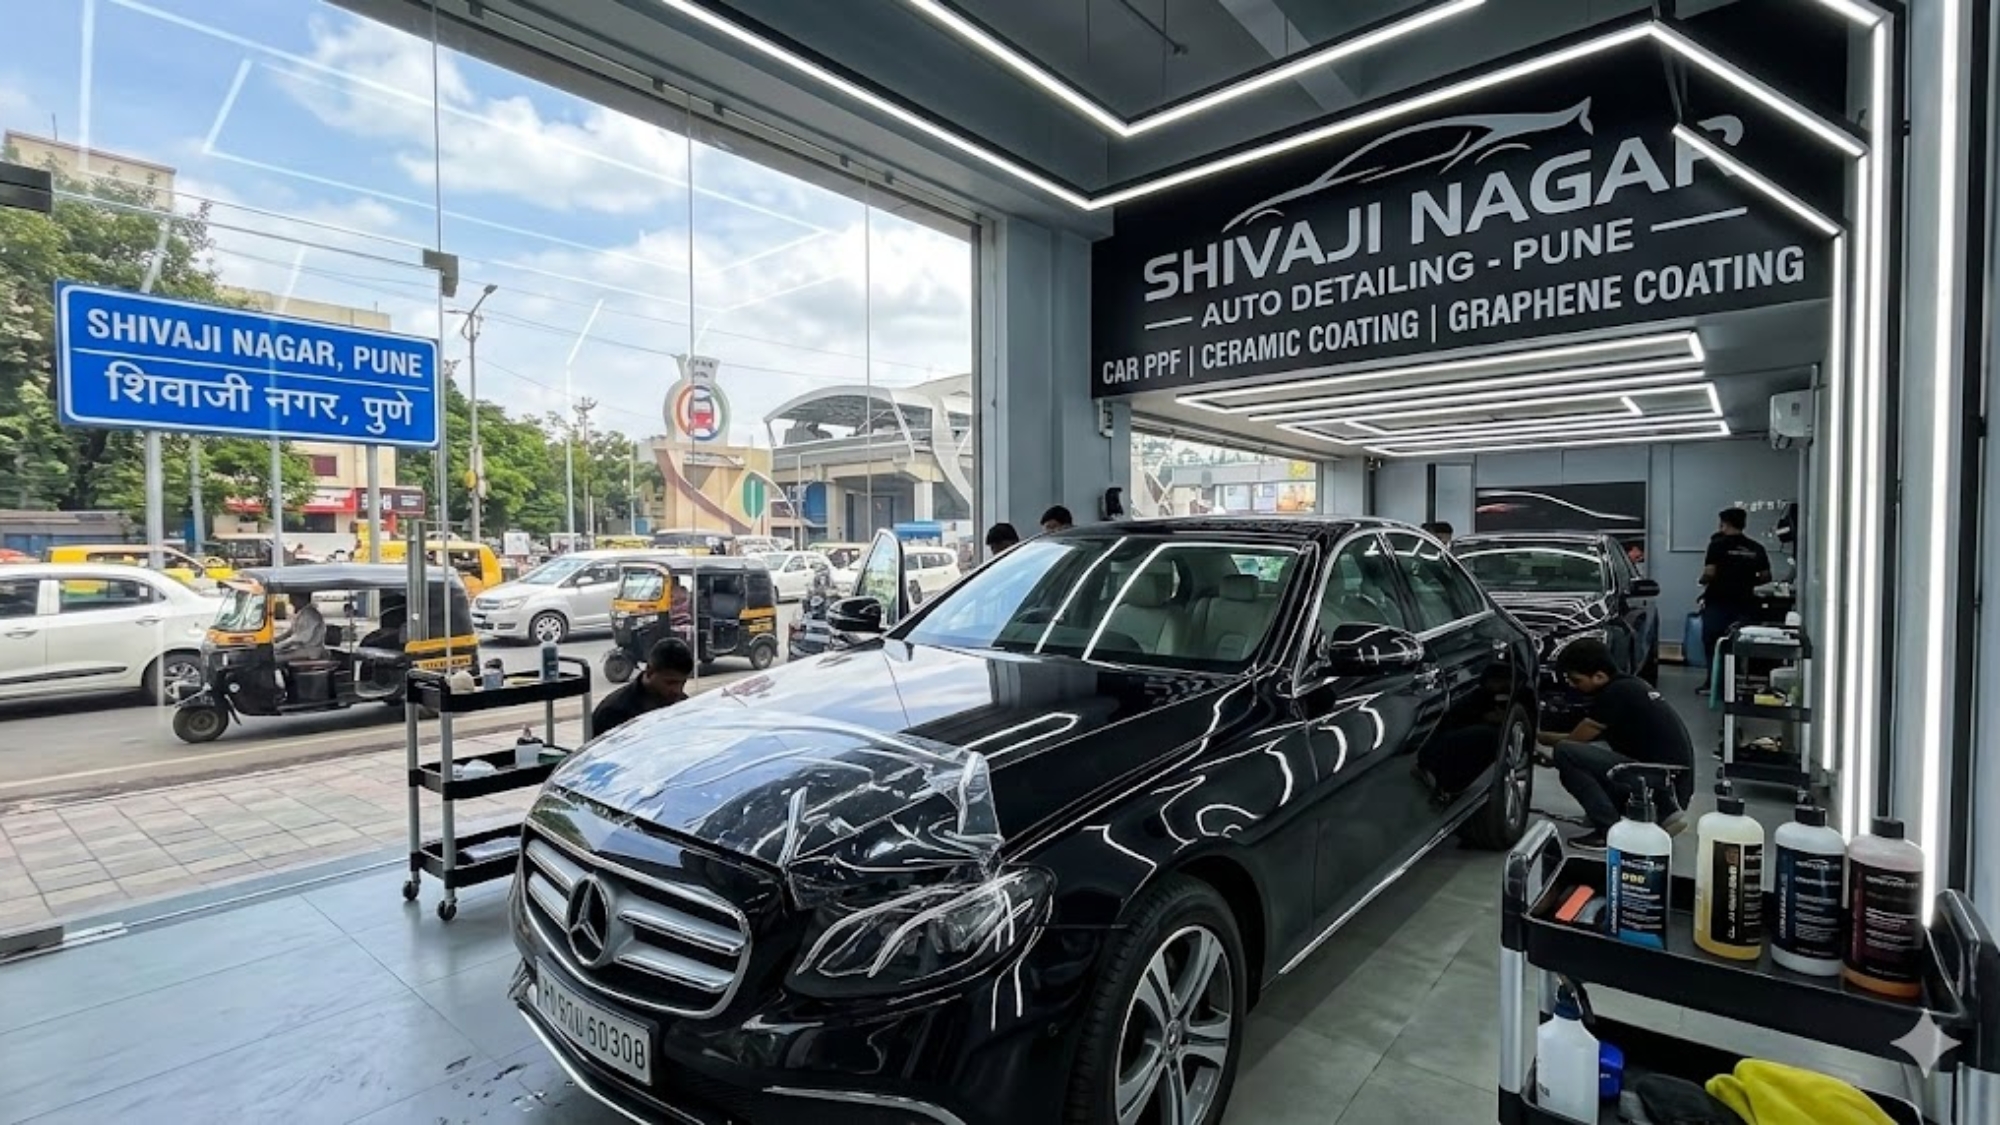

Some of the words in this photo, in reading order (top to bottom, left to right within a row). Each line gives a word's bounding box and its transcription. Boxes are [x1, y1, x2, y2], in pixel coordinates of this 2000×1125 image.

[1144, 203, 1381, 303] SHIVAJI
[1410, 114, 1744, 244] NAGAR
[1102, 357, 1140, 385] CAR
[1144, 348, 1182, 378] PPF
[1200, 328, 1301, 370] CERAMIC
[1308, 309, 1419, 354] COATING
[1448, 273, 1622, 333] GRAPHENE
[1632, 245, 1806, 306] COATING
[1201, 288, 1283, 328] AUTO
[1291, 252, 1475, 311] DETAILING
[1512, 218, 1634, 271] PUNE
[87, 307, 222, 353] SHIVAJI
[232, 329, 343, 371] NAGAR,
[353, 344, 423, 379] PUNE
[105, 359, 252, 413] शिवाजी
[264, 385, 350, 426] नगर,
[361, 390, 413, 433] पुणे
